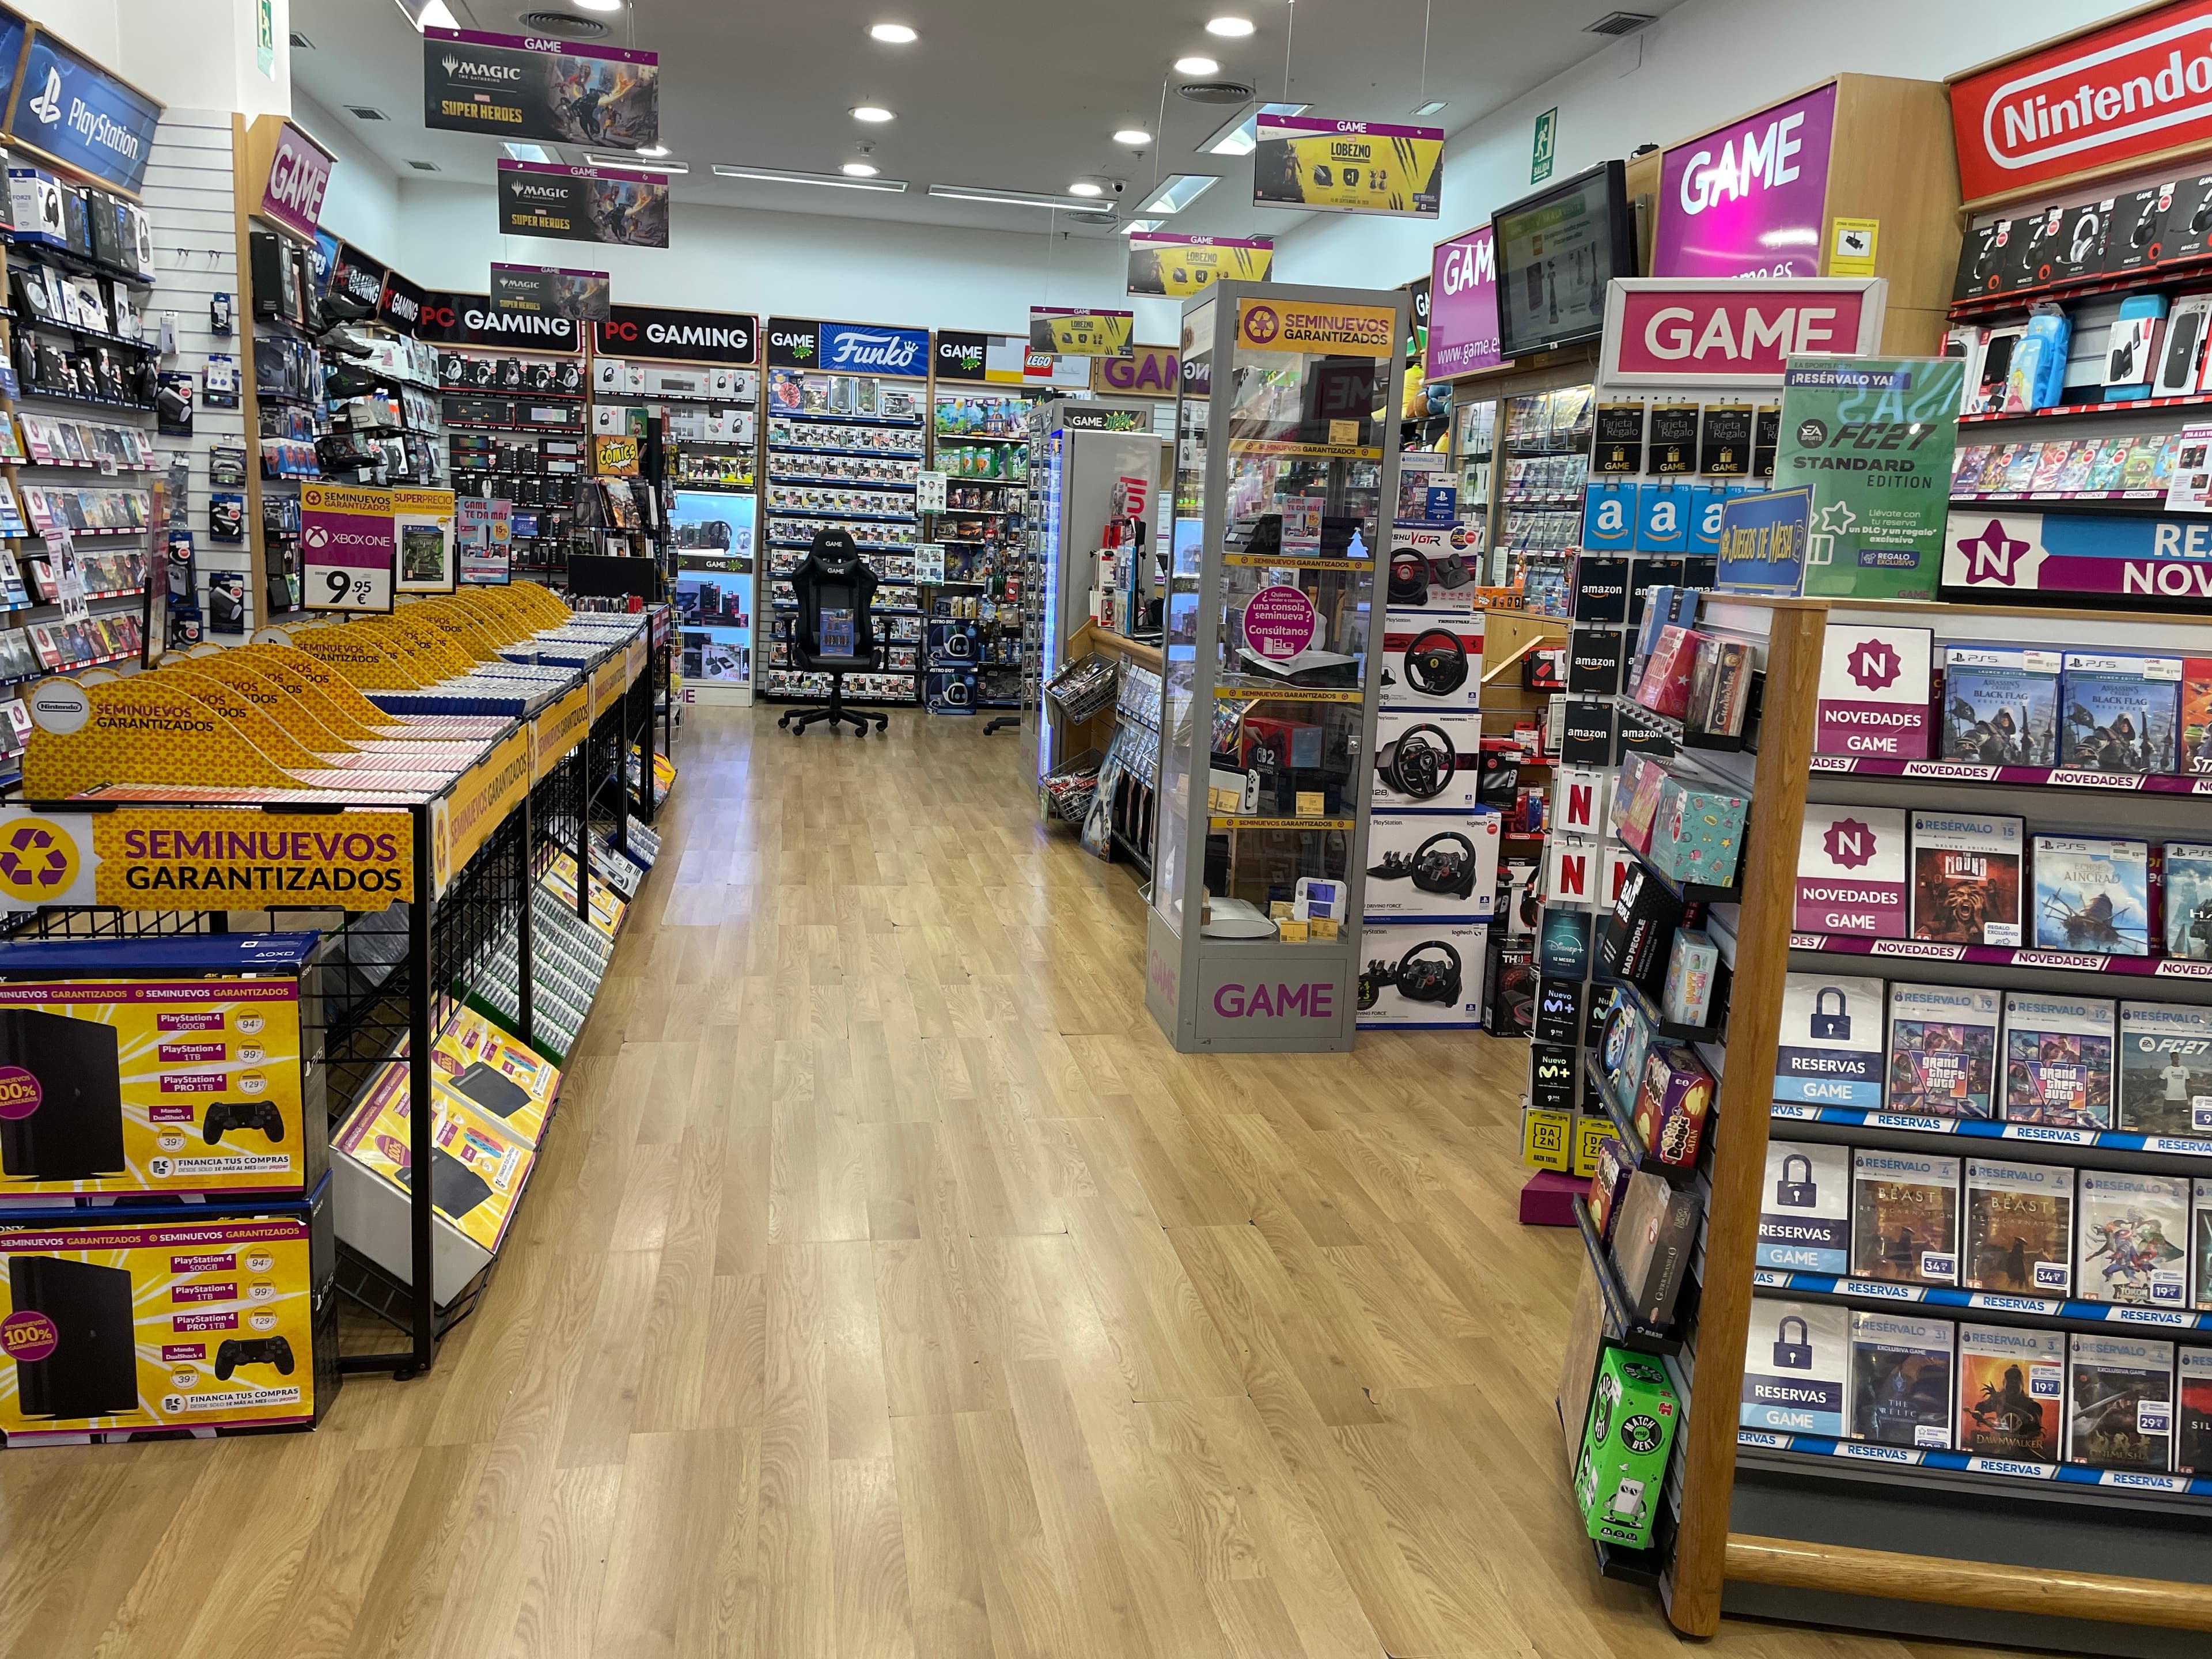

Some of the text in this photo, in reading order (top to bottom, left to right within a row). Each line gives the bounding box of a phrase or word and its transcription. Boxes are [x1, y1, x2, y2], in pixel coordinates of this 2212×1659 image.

[524, 38, 562, 52] GAME
[458, 61, 521, 81] MAGIC
[2003, 42, 2212, 149] Nintendo
[442, 100, 522, 123] SUPER HEROES
[68, 97, 138, 160] PlayStation
[1337, 121, 1366, 133] GAME
[1331, 142, 1370, 158] LOBEZNO
[1680, 111, 1805, 215] GAME
[1533, 165, 1550, 176] SALIDA
[270, 143, 328, 223] GAME
[523, 184, 569, 199] MAGIC
[2137, 191, 2152, 200] GAME
[512, 213, 570, 230] SUPER HEROES
[1191, 236, 1213, 244] GAME
[1186, 252, 1217, 263] LOBEZNO
[1443, 234, 1495, 296] GAM
[349, 270, 380, 304] GAMING
[509, 280, 539, 289] MAGIC
[392, 293, 418, 321] GAMING
[421, 307, 570, 336] PC GAMING
[1285, 315, 1388, 333] SEMINUEVOS
[605, 322, 748, 348] PC GAMING
[771, 332, 815, 348] GAME
[1285, 329, 1388, 345] GARANTIZADOS
[1645, 308, 1836, 361] GAME
[833, 332, 913, 367] Funko
[940, 344, 983, 359] GAME
[1437, 337, 1500, 365] www.game.e
[1026, 355, 1052, 368] LEGO
[1791, 372, 1893, 386] ¡RESÉRVALO YA!
[1073, 416, 1102, 427] GAME
[1601, 419, 1633, 431] Tarjeta
[1656, 420, 1687, 433] Tarjeta
[1607, 427, 1638, 438] Regalo
[1662, 429, 1694, 438] Regalo
[1828, 422, 1937, 450] FC27
[599, 441, 637, 465] COMICS
[1302, 446, 1356, 455] GARANTIZADOS
[1793, 456, 1915, 472] STANDARD
[1867, 475, 1932, 488] EDITION
[324, 492, 391, 504] SEMINUEVOS
[395, 493, 452, 504] SUPERPRECIO
[324, 501, 390, 512] GARANTIZADOS
[464, 501, 487, 510] GAME
[1597, 500, 1623, 530] a
[1869, 509, 1900, 518] Llévate
[1862, 526, 1881, 534] DLC
[1882, 528, 1888, 536] y
[332, 533, 390, 547] XBOX ONE
[1728, 521, 1793, 564] JUEGOS DE MESA
[1870, 536, 1914, 544] exclusivo
[1877, 552, 1910, 560] REGALO
[1975, 541, 2010, 576] N
[1253, 558, 1349, 569] SEMINUEVOS GARANTIZADOS
[1582, 585, 1622, 595] amazon
[1271, 603, 1305, 611] consola
[1255, 611, 1303, 620] seminueva
[1249, 625, 1308, 635] Consúltanos
[1575, 657, 1615, 666] amazon
[1862, 653, 1885, 677] N
[1968, 654, 1998, 662] PS5
[1974, 690, 2028, 700] BLACK FLAG
[97, 704, 192, 718] SEMINUEVOS
[97, 717, 213, 732] GARANTIZADOS
[1825, 710, 1921, 727] NOVEDADES
[1847, 736, 1897, 752] GAME
[1910, 764, 1988, 777] NOVEDADES
[450, 752, 527, 848] SEMINUEVOS GARANTIZADOS
[1925, 819, 1993, 834] RESÉRVALO
[125, 830, 397, 862] SEMINUEVOS
[1945, 855, 1987, 877] MOUND
[126, 865, 401, 892] GARANTIZADOS
[2064, 872, 2120, 885] AINCRAD
[2018, 953, 2097, 968] NOVEDADES
[146, 987, 289, 998] SEMINUEVOS GARANTIZADOS
[1548, 989, 1571, 1000] Nuevo
[1904, 992, 1971, 1006] RESÉRVALO
[1213, 983, 1334, 1018] GAME
[161, 1014, 211, 1023] PlayStation
[1791, 1057, 1866, 1074] RESERVAS
[1922, 1055, 1959, 1069] grand
[164, 1075, 214, 1084] PlayStation
[1929, 1067, 1965, 1080] theft
[1804, 1082, 1852, 1099] GAME
[1926, 1078, 1955, 1089] auto
[1878, 1115, 1941, 1129] RESERVAS
[1687, 1129, 1698, 1153] CATAN
[179, 1158, 222, 1166] FINANCIA
[245, 1156, 289, 1164] COMPRAS
[1866, 1158, 1930, 1172] RESÉRVALO
[1878, 1187, 1935, 1203] BEAST
[160, 1228, 300, 1242] SEMINUEVOS GARANTIZADOS
[1847, 1282, 1908, 1297] RESERVAS
[1983, 1297, 2044, 1311] RESERVAS
[5, 1327, 52, 1345] 100%
[1877, 1346, 1908, 1354] EXCLUSIVA
[1624, 1416, 1656, 1432] MATCH
[1635, 1429, 1648, 1437] my
[1633, 1440, 1655, 1450] BEAT
[2114, 1474, 2173, 1488] RESERVAS
